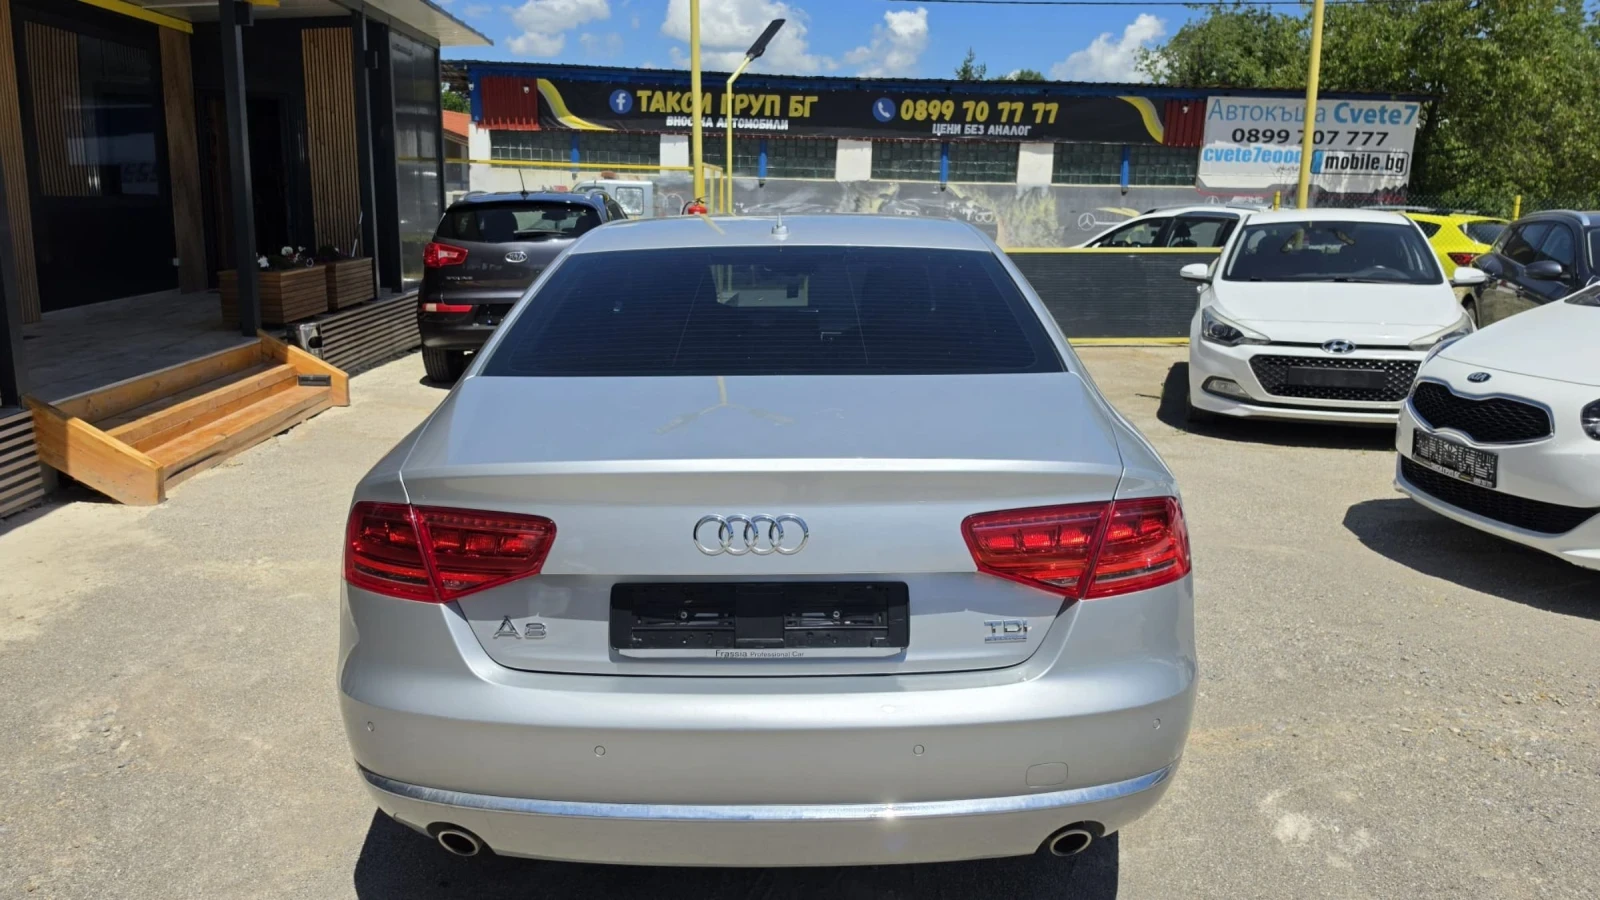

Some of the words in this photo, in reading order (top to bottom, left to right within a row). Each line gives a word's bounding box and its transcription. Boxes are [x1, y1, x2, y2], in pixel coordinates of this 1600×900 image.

[636, 90, 712, 114] ТАКСИ
[719, 93, 781, 117] ГРУП
[788, 95, 819, 118] БГ
[900, 98, 955, 122] 0899
[962, 100, 990, 123] 70
[997, 101, 1025, 124] 77
[1032, 102, 1060, 125] 77
[1333, 102, 1419, 125] Cvete7
[932, 123, 961, 136] ЦЕНИ
[964, 124, 985, 135] БЕЗ
[987, 124, 1032, 137] АНАЛОГ
[1231, 128, 1290, 145] 0899
[1347, 131, 1390, 147] 777
[1325, 152, 1406, 174] mobile.bg
[715, 649, 748, 658] Frassia
[750, 650, 791, 658] Professional
